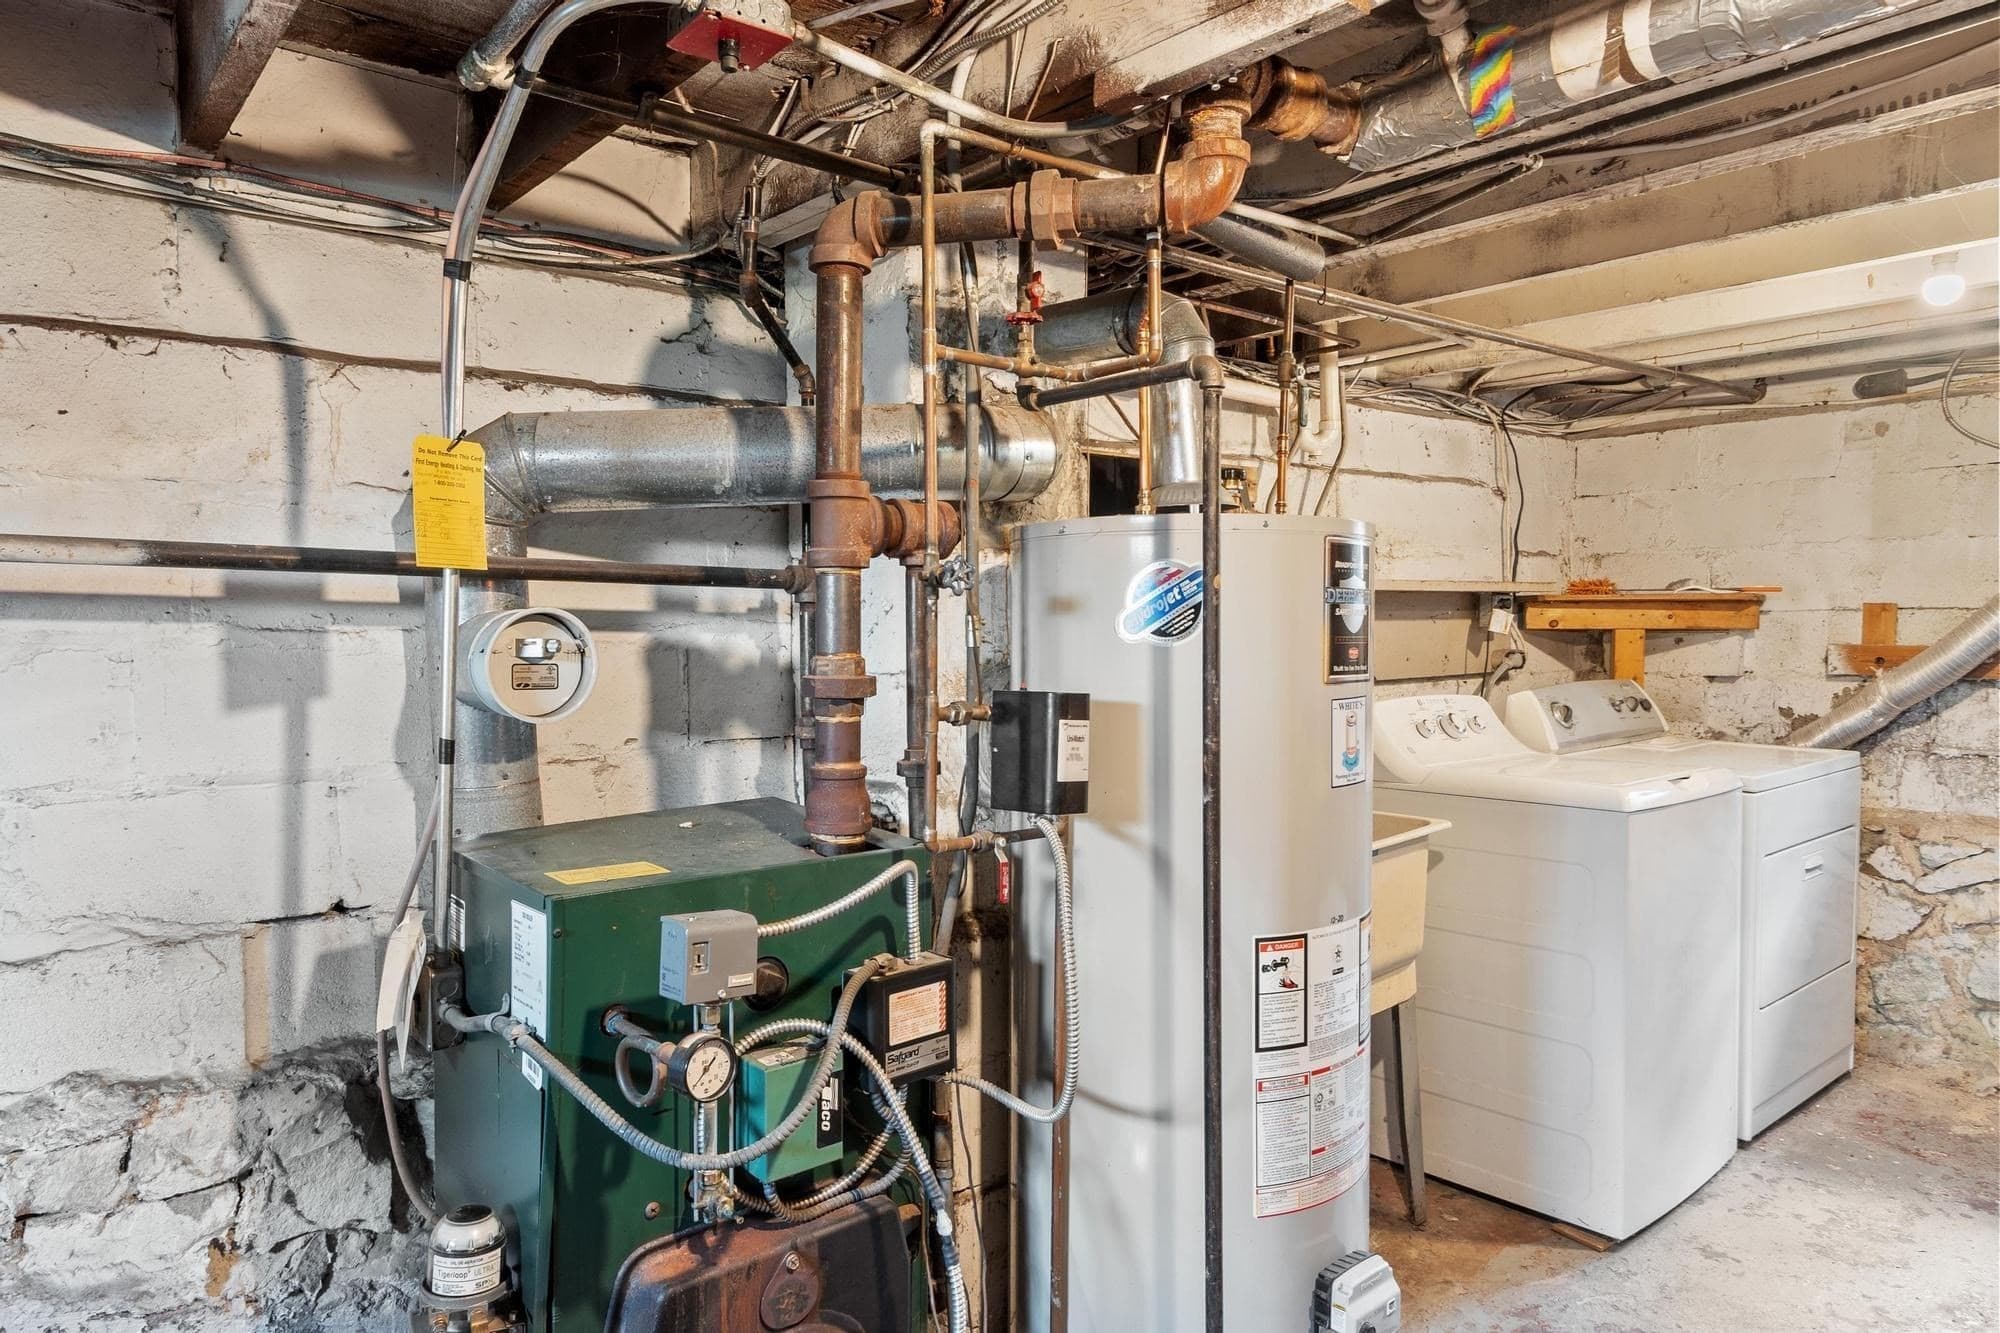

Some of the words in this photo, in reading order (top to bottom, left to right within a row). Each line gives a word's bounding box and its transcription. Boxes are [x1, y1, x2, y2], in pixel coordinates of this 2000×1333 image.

[1274, 942, 1299, 950] DANGER
[887, 1046, 920, 1065] Safgard
[438, 1269, 468, 1279] Tigerloop
